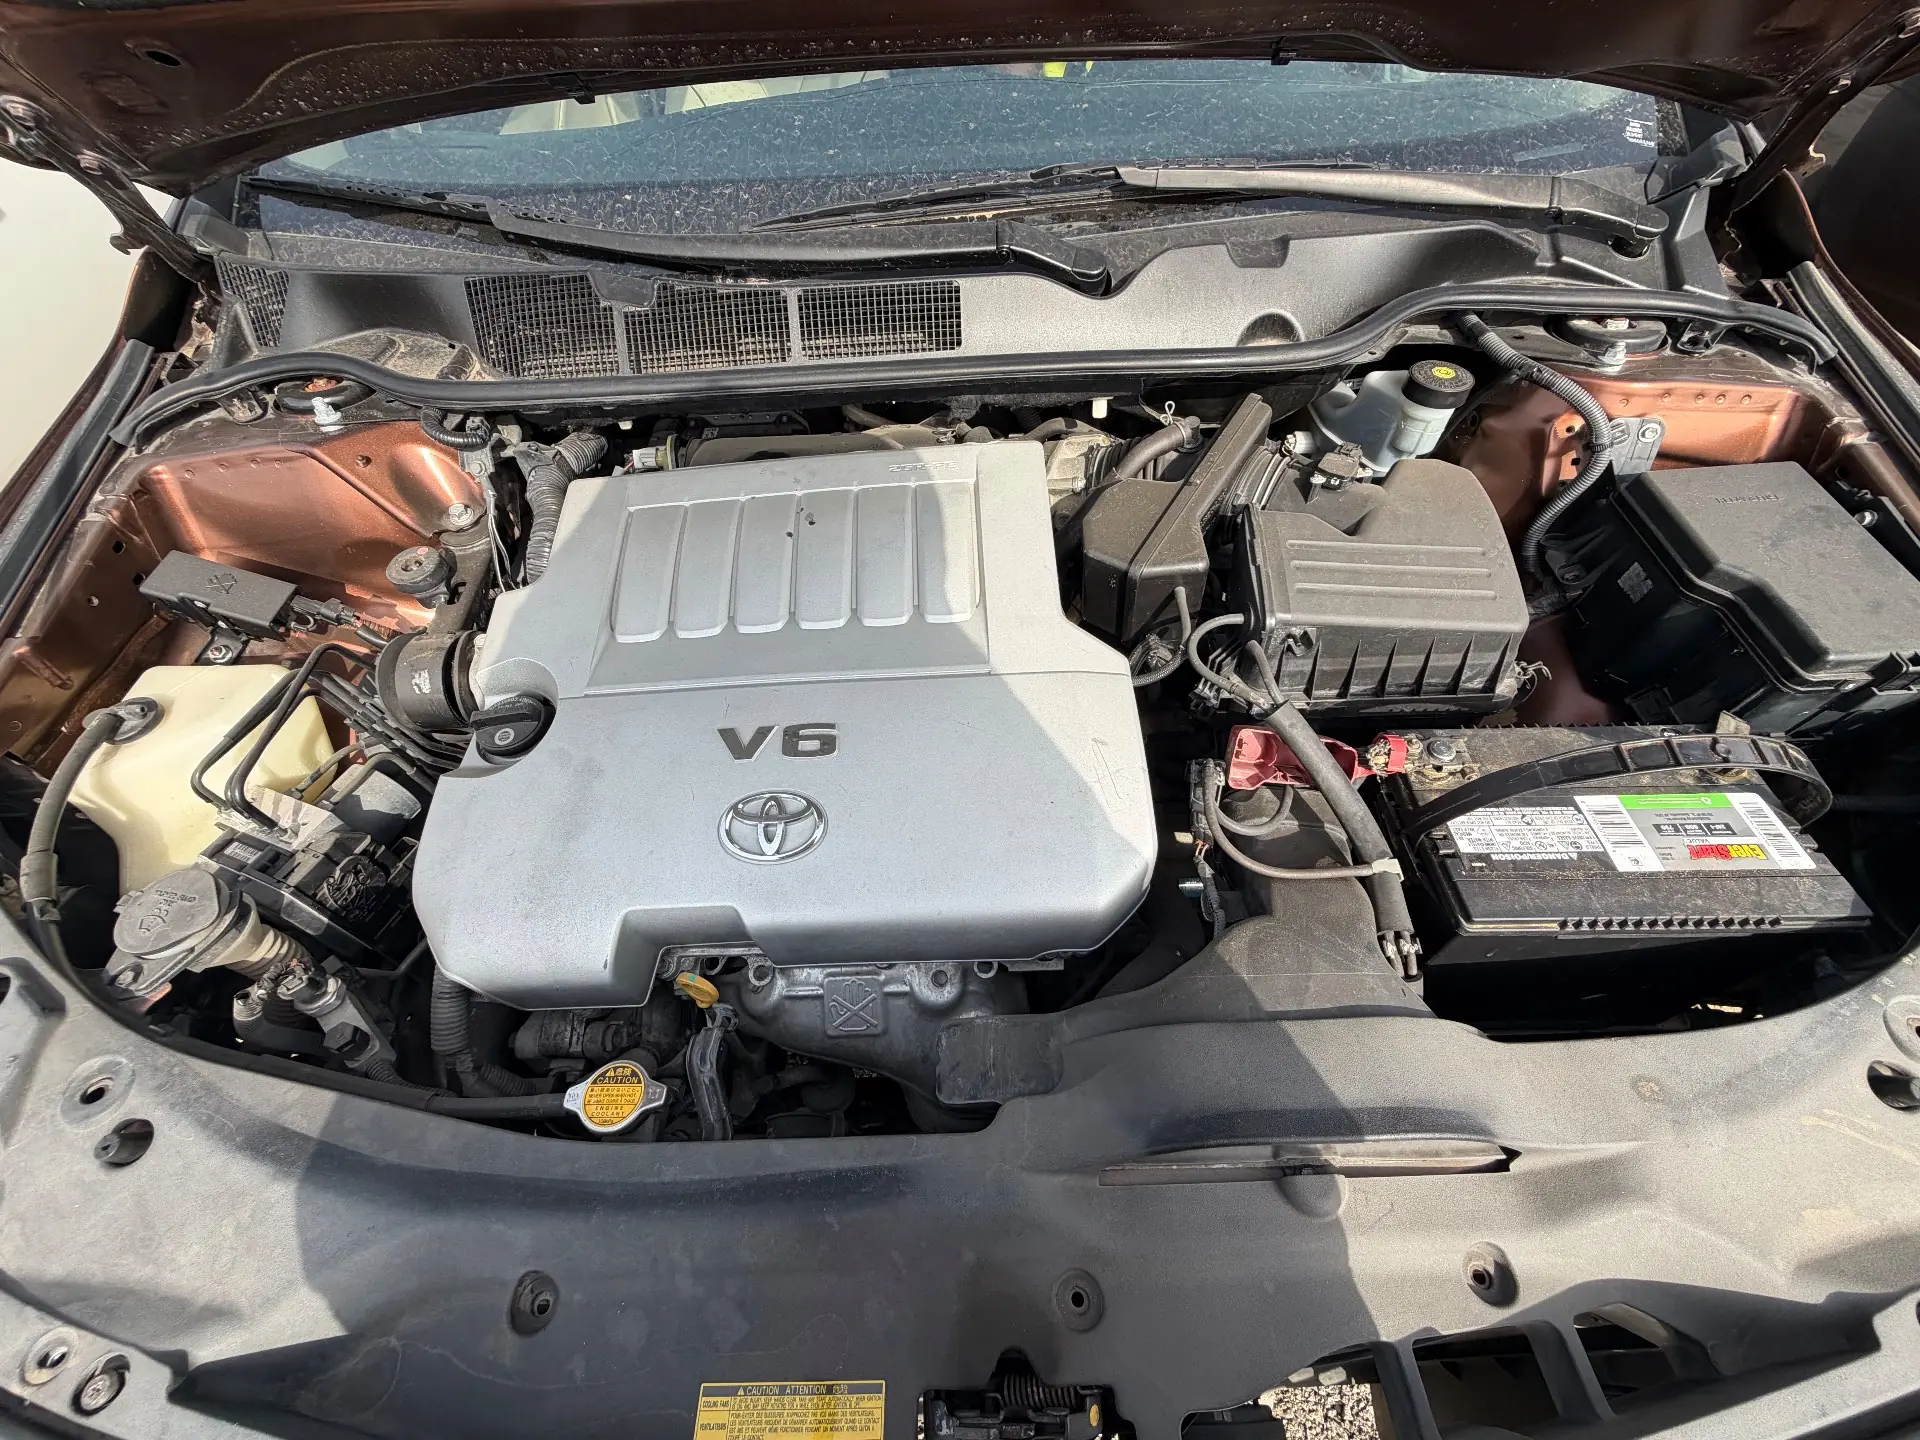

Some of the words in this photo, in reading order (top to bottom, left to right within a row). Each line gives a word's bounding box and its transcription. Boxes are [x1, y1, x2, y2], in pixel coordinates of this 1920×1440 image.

[716, 722, 838, 762] V6
[1490, 852, 1570, 861] DANGER/POISON
[1686, 843, 1769, 861] EverStart
[596, 1076, 639, 1084] CAUTION
[746, 1385, 780, 1395] CAUTION
[785, 1384, 827, 1395] ATTENTION
[702, 1400, 719, 1409] COOLING
[719, 1400, 729, 1408] FANS
[699, 1422, 727, 1431] VENTILATEURS
